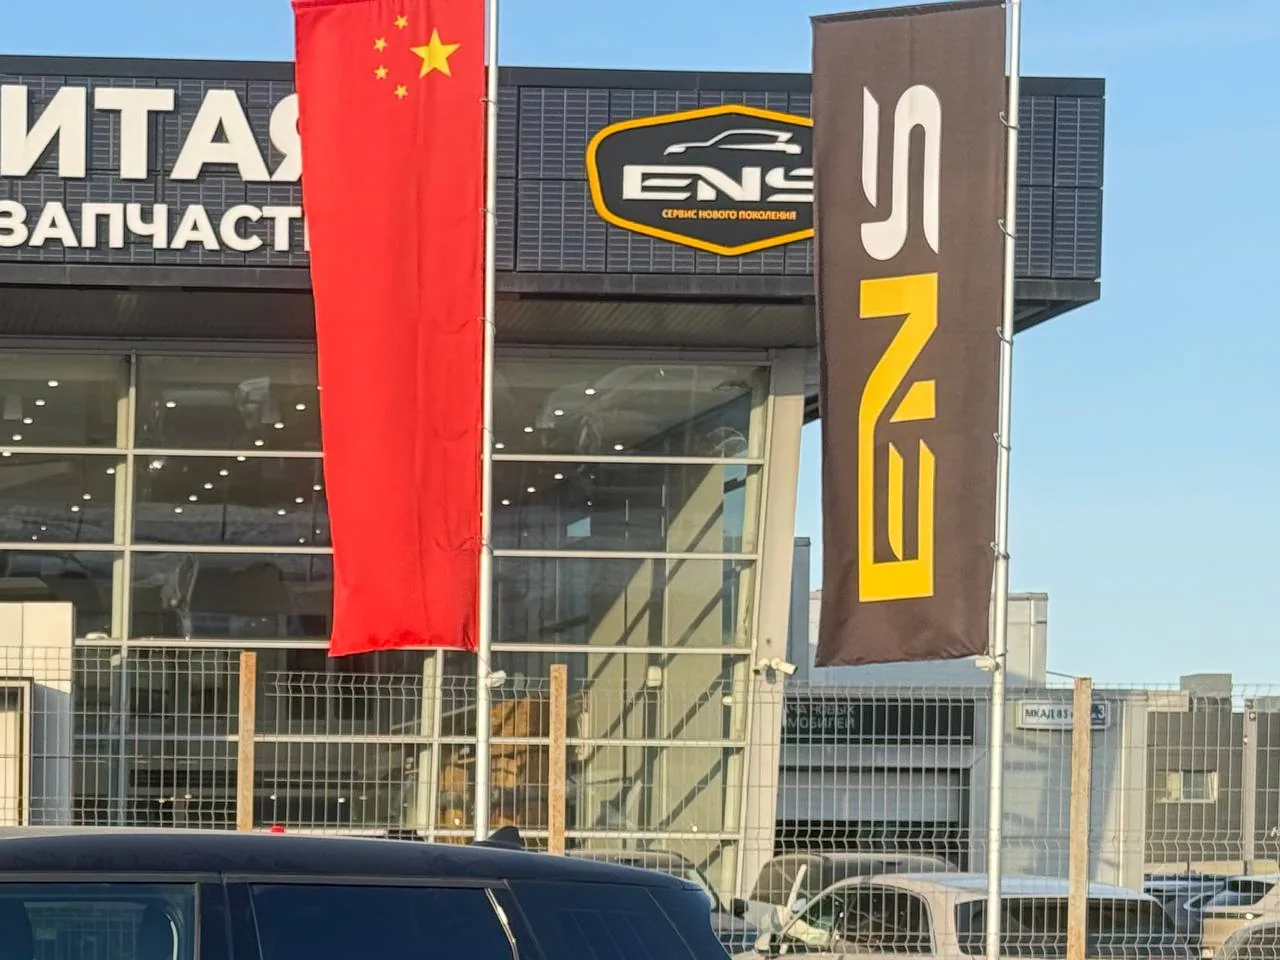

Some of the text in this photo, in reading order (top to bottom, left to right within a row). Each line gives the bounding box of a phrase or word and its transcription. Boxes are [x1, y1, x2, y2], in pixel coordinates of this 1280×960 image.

[662, 208, 797, 221] СЕРВИС НОВОГО ПОКОЛЕНИЯ
[857, 84, 942, 603] ENS
